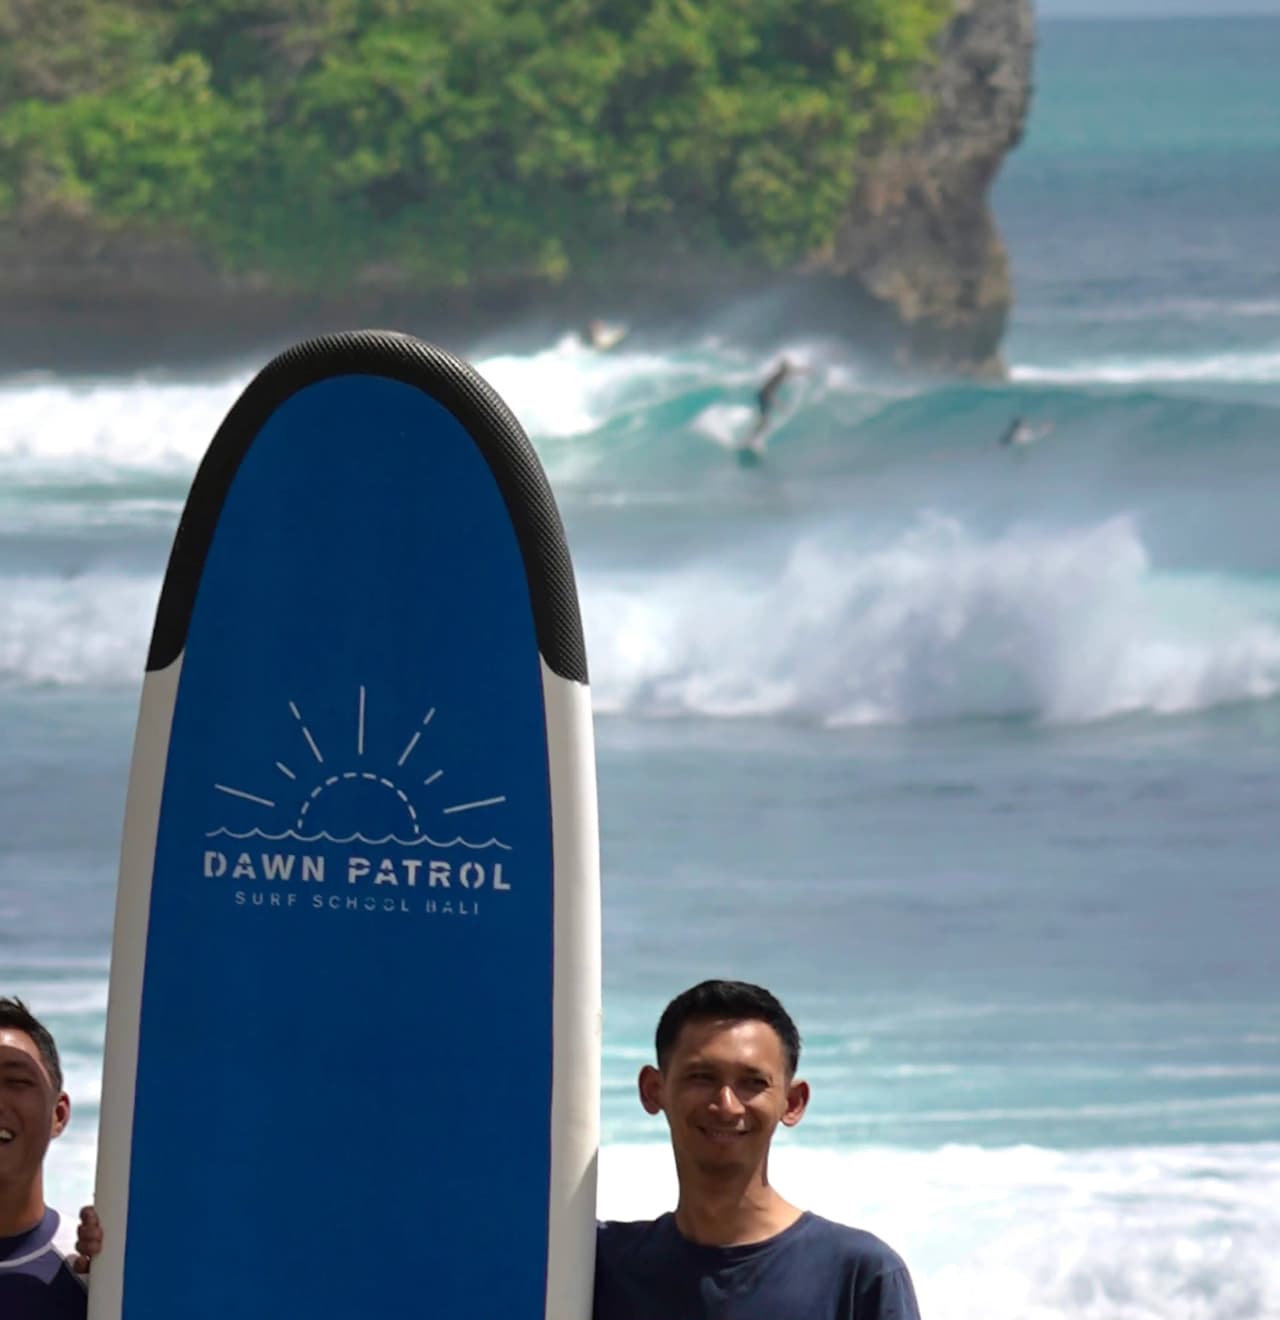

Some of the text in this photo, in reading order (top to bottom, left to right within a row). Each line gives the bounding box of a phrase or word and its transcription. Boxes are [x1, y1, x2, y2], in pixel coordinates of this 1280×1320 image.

[203, 850, 512, 890] DAWN PATROL
[235, 890, 480, 915] SURF SCHOOL BALI
